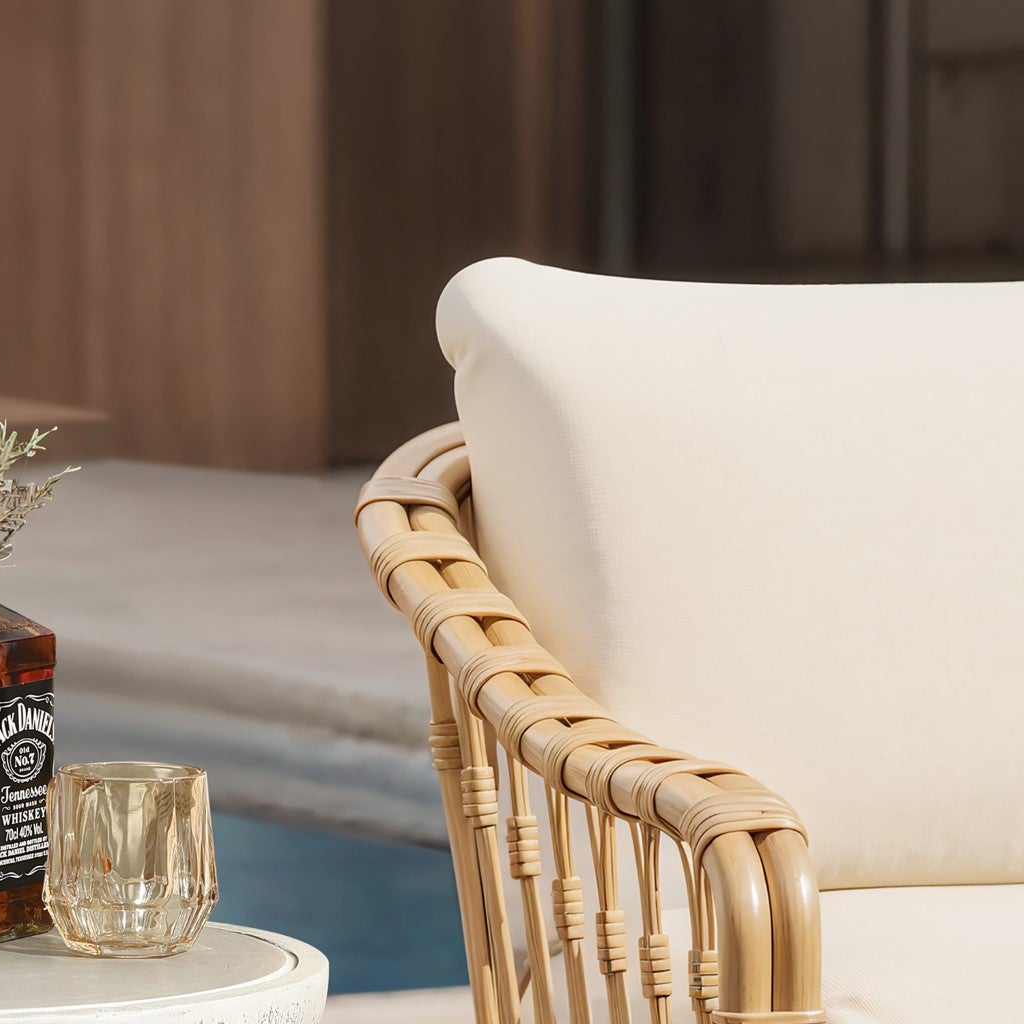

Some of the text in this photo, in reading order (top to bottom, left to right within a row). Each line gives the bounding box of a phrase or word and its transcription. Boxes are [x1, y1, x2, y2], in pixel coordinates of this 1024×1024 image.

[19, 746, 30, 754] Old
[1, 785, 47, 803] Tennessee
[2, 807, 46, 826] WHISKEY
[5, 827, 18, 841] 70cl
[19, 823, 32, 838] 40%
